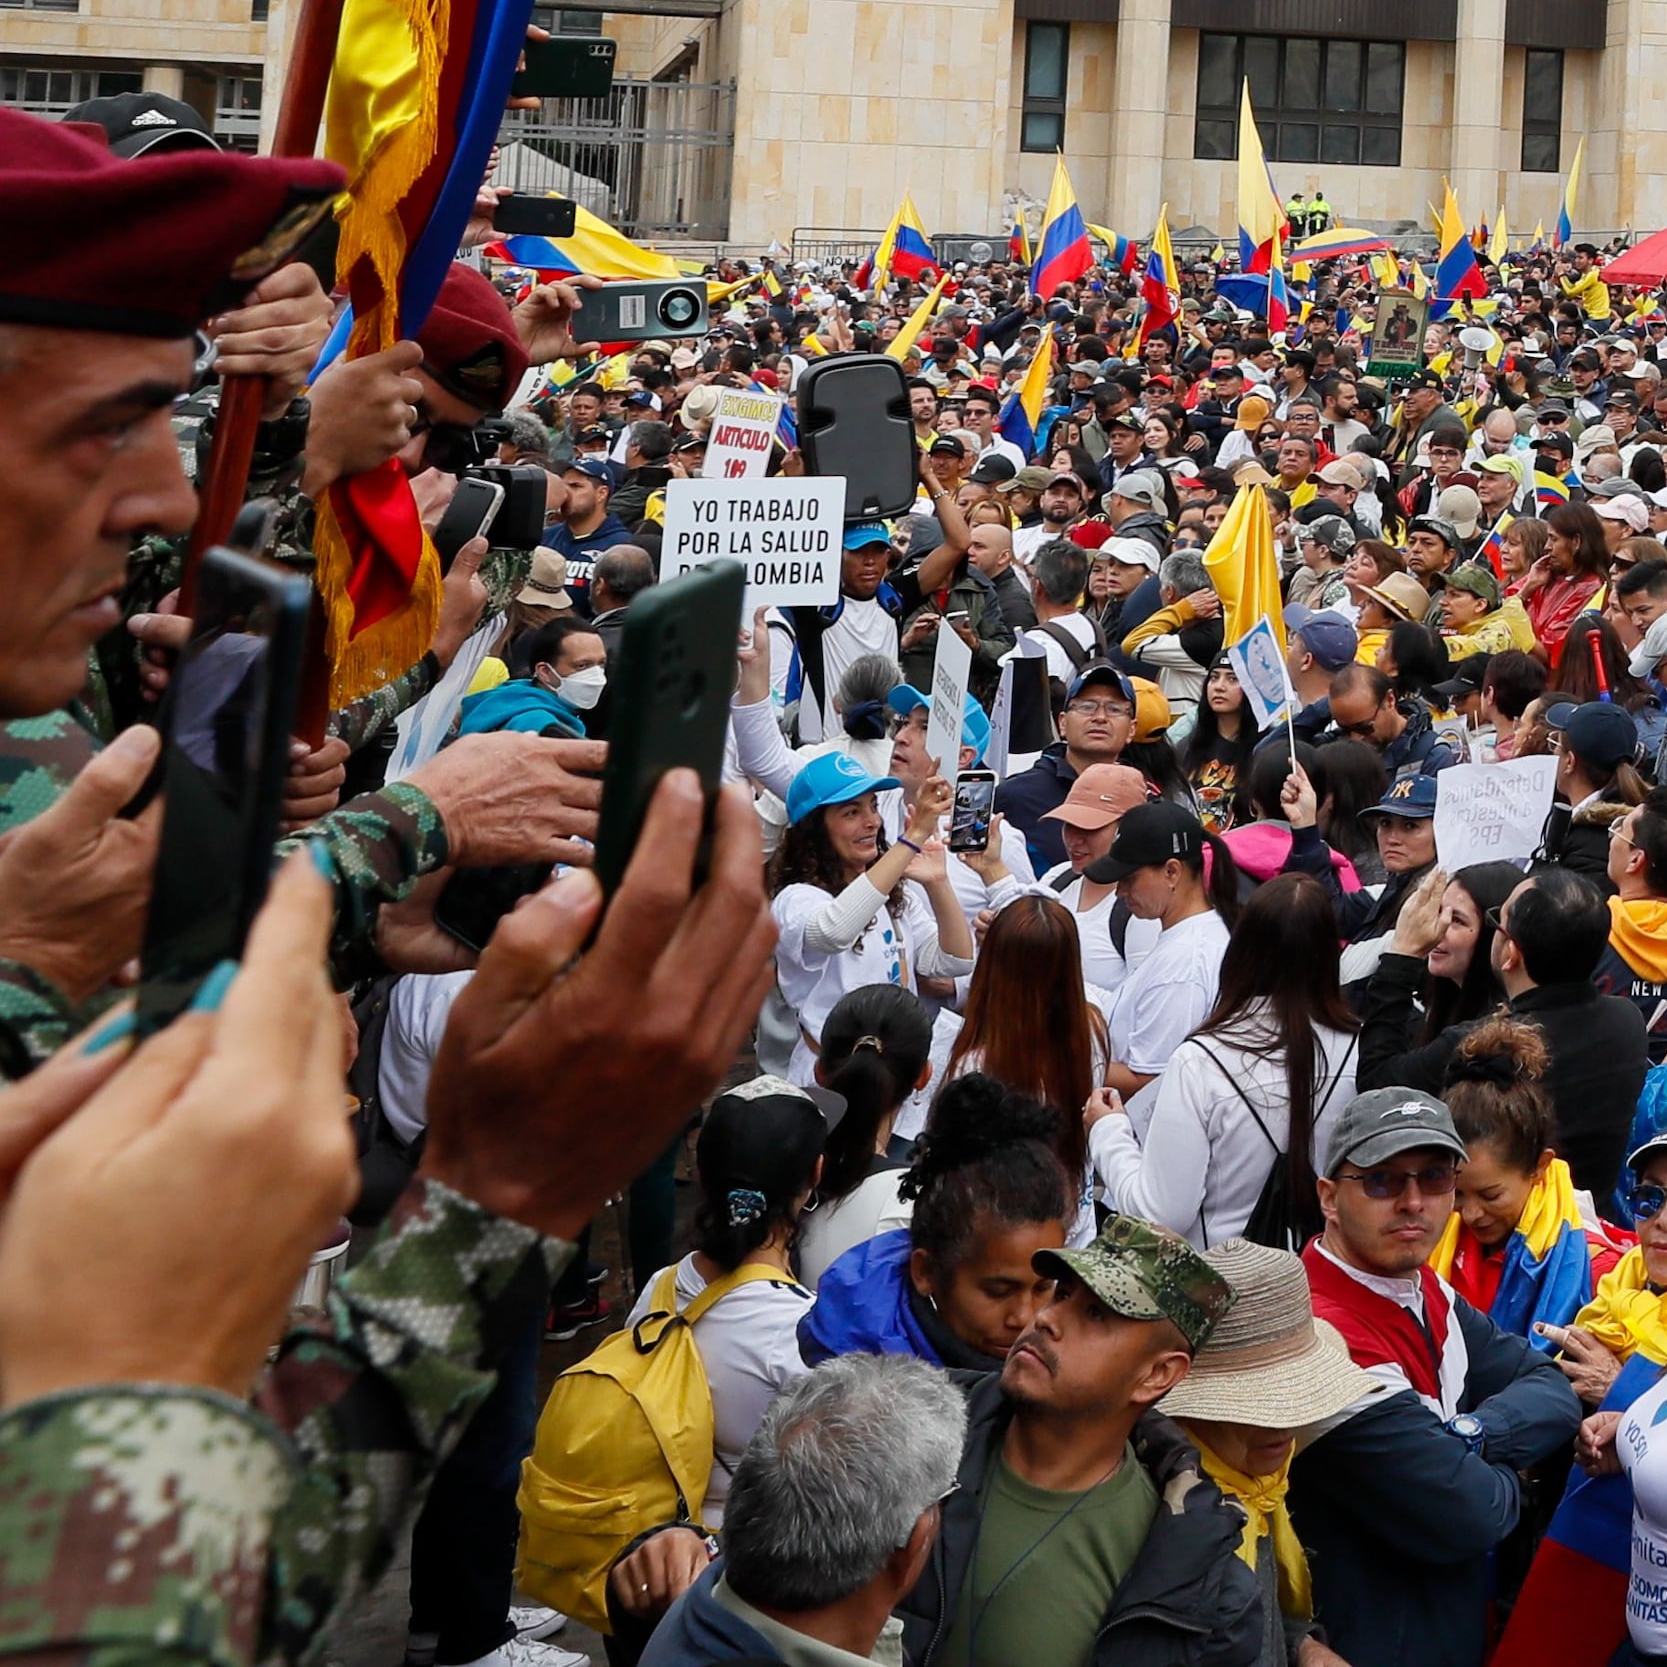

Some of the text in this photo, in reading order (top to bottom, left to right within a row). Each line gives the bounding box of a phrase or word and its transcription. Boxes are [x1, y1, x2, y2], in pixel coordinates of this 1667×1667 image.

[720, 395, 778, 423] EXIGIMOS
[714, 426, 770, 452] ARTICULO
[724, 458, 747, 478] 109
[693, 497, 820, 524] YO TRABAJO
[677, 529, 830, 555] POR LA SALUD
[744, 562, 825, 585] LOMBIA
[1631, 980, 1662, 997] NEW
[1625, 1420, 1649, 1465] YO SOY
